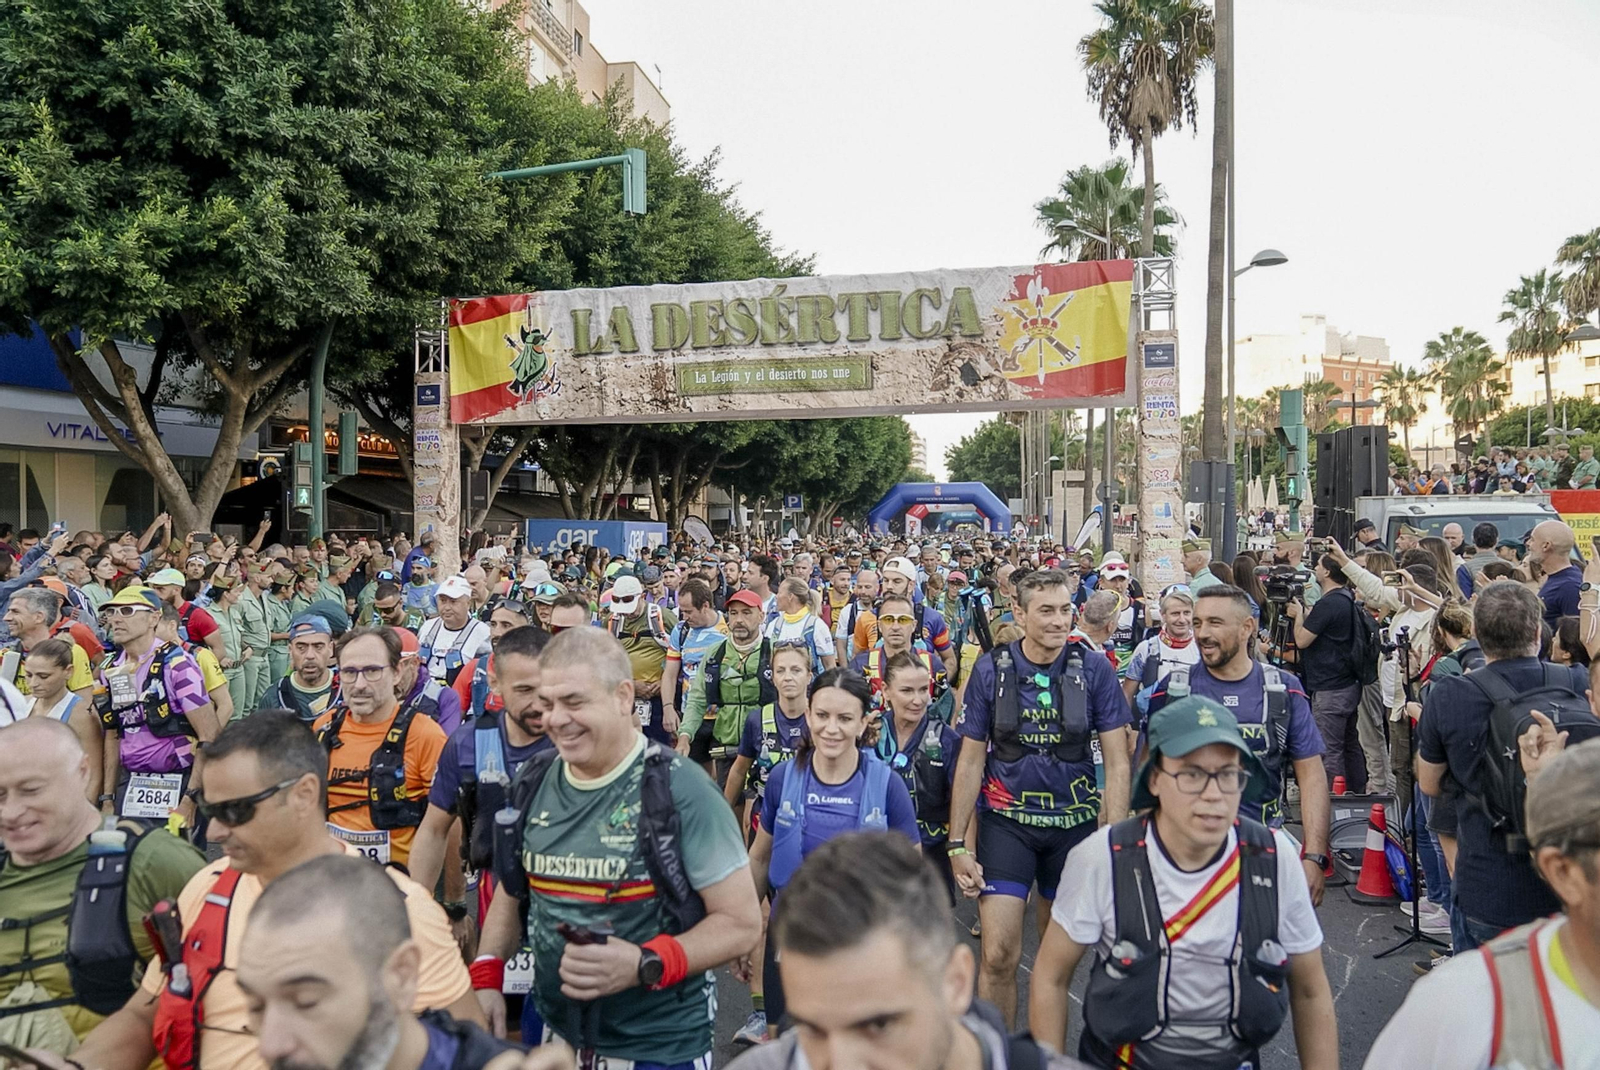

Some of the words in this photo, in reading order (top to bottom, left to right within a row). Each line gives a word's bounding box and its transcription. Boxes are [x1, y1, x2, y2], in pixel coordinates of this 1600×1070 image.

[571, 305, 640, 357] LA
[650, 284, 984, 350] DESÉRTICA
[695, 371, 707, 384] La
[711, 369, 740, 385] Legión
[744, 371, 751, 384] y
[755, 368, 765, 381] el
[769, 367, 807, 381] desierto
[811, 369, 828, 379] nos
[832, 367, 850, 379] une
[1146, 401, 1175, 409] RENTA
[361, 440, 382, 451] CLUB
[788, 496, 798, 507] P
[556, 527, 598, 549] gar
[630, 530, 645, 550] gar
[136, 789, 171, 805] 2684
[821, 795, 853, 805] LURBEL
